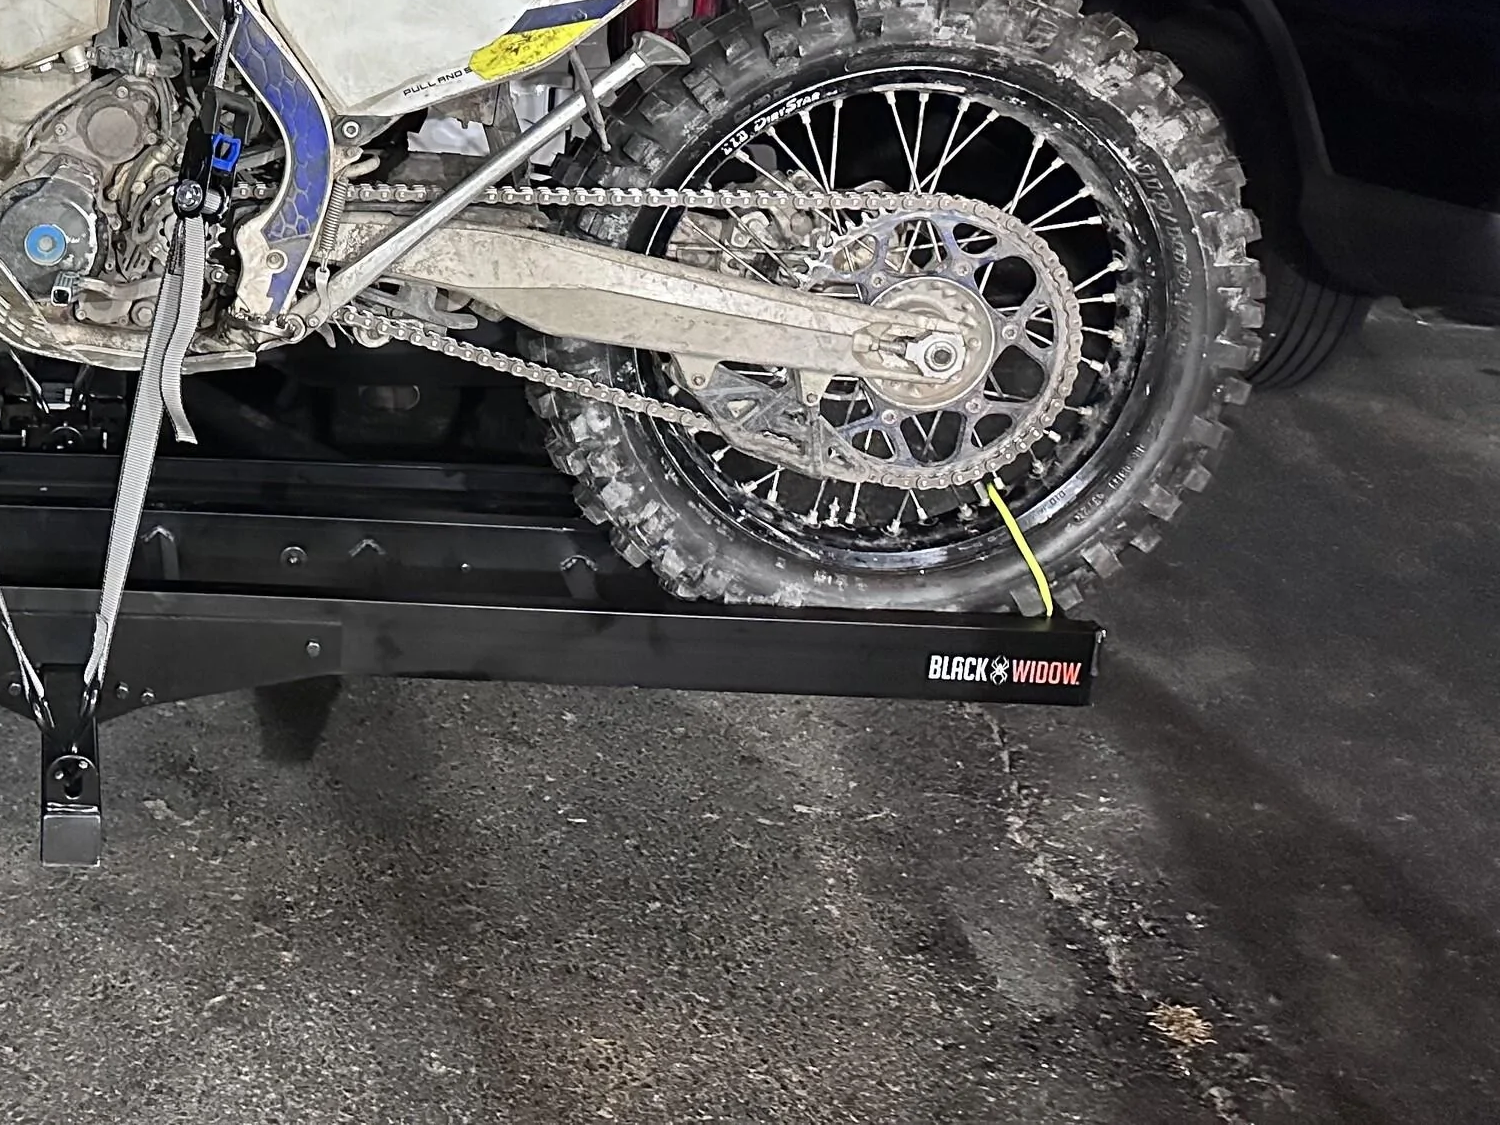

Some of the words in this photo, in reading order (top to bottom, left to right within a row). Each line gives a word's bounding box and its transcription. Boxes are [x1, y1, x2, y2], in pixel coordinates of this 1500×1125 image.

[403, 81, 437, 97] PULL
[437, 70, 464, 84] AND
[928, 655, 990, 682] BLACK
[1012, 659, 1082, 686] WIDOW
